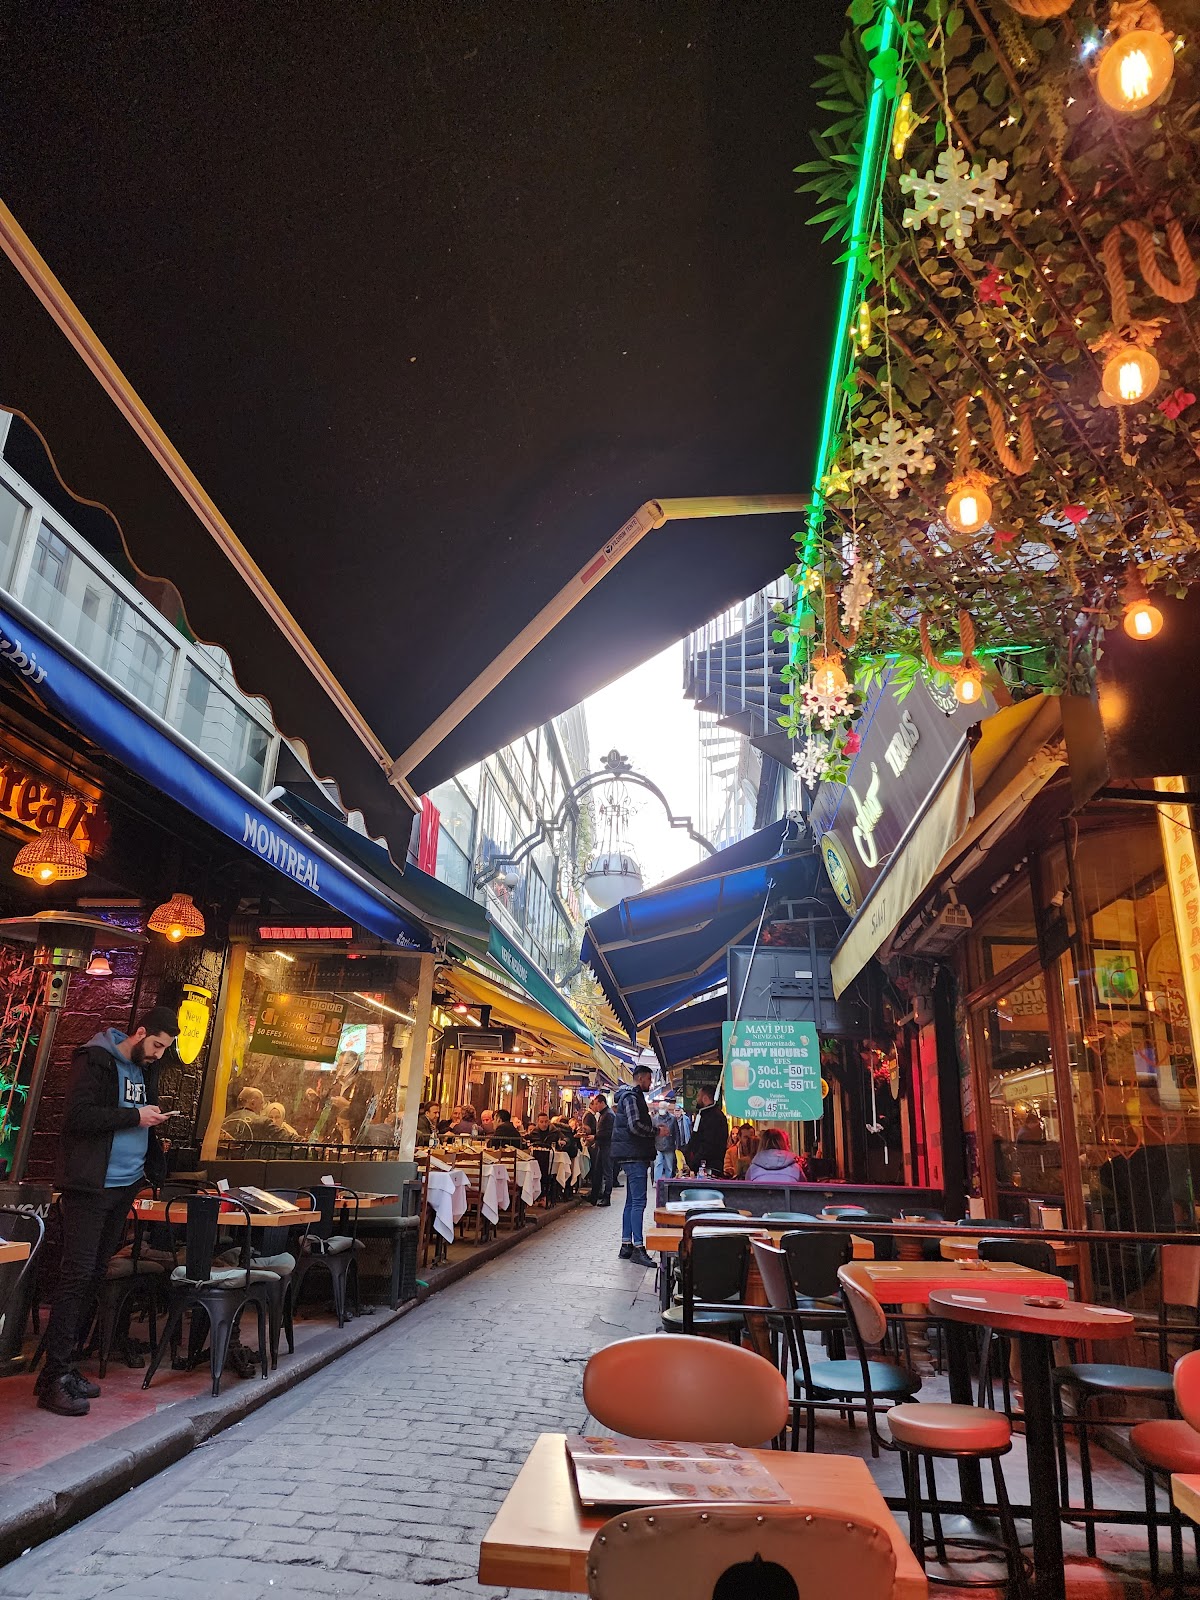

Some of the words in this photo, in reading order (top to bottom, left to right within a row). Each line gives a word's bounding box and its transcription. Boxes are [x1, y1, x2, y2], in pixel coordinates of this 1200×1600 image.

[884, 709, 920, 778] TERAS
[243, 812, 320, 892] MONTREAL
[310, 1000, 343, 1013] HOUR
[266, 1029, 282, 1038] EFES
[745, 1023, 772, 1034] MAVİ
[774, 1025, 795, 1034] PUB
[731, 1048, 768, 1058] HAPPY
[769, 1048, 808, 1058] HOURS
[758, 1079, 783, 1089] 50cl.
[767, 1103, 777, 1112] 45
[2, 1203, 51, 1220] GAZ
